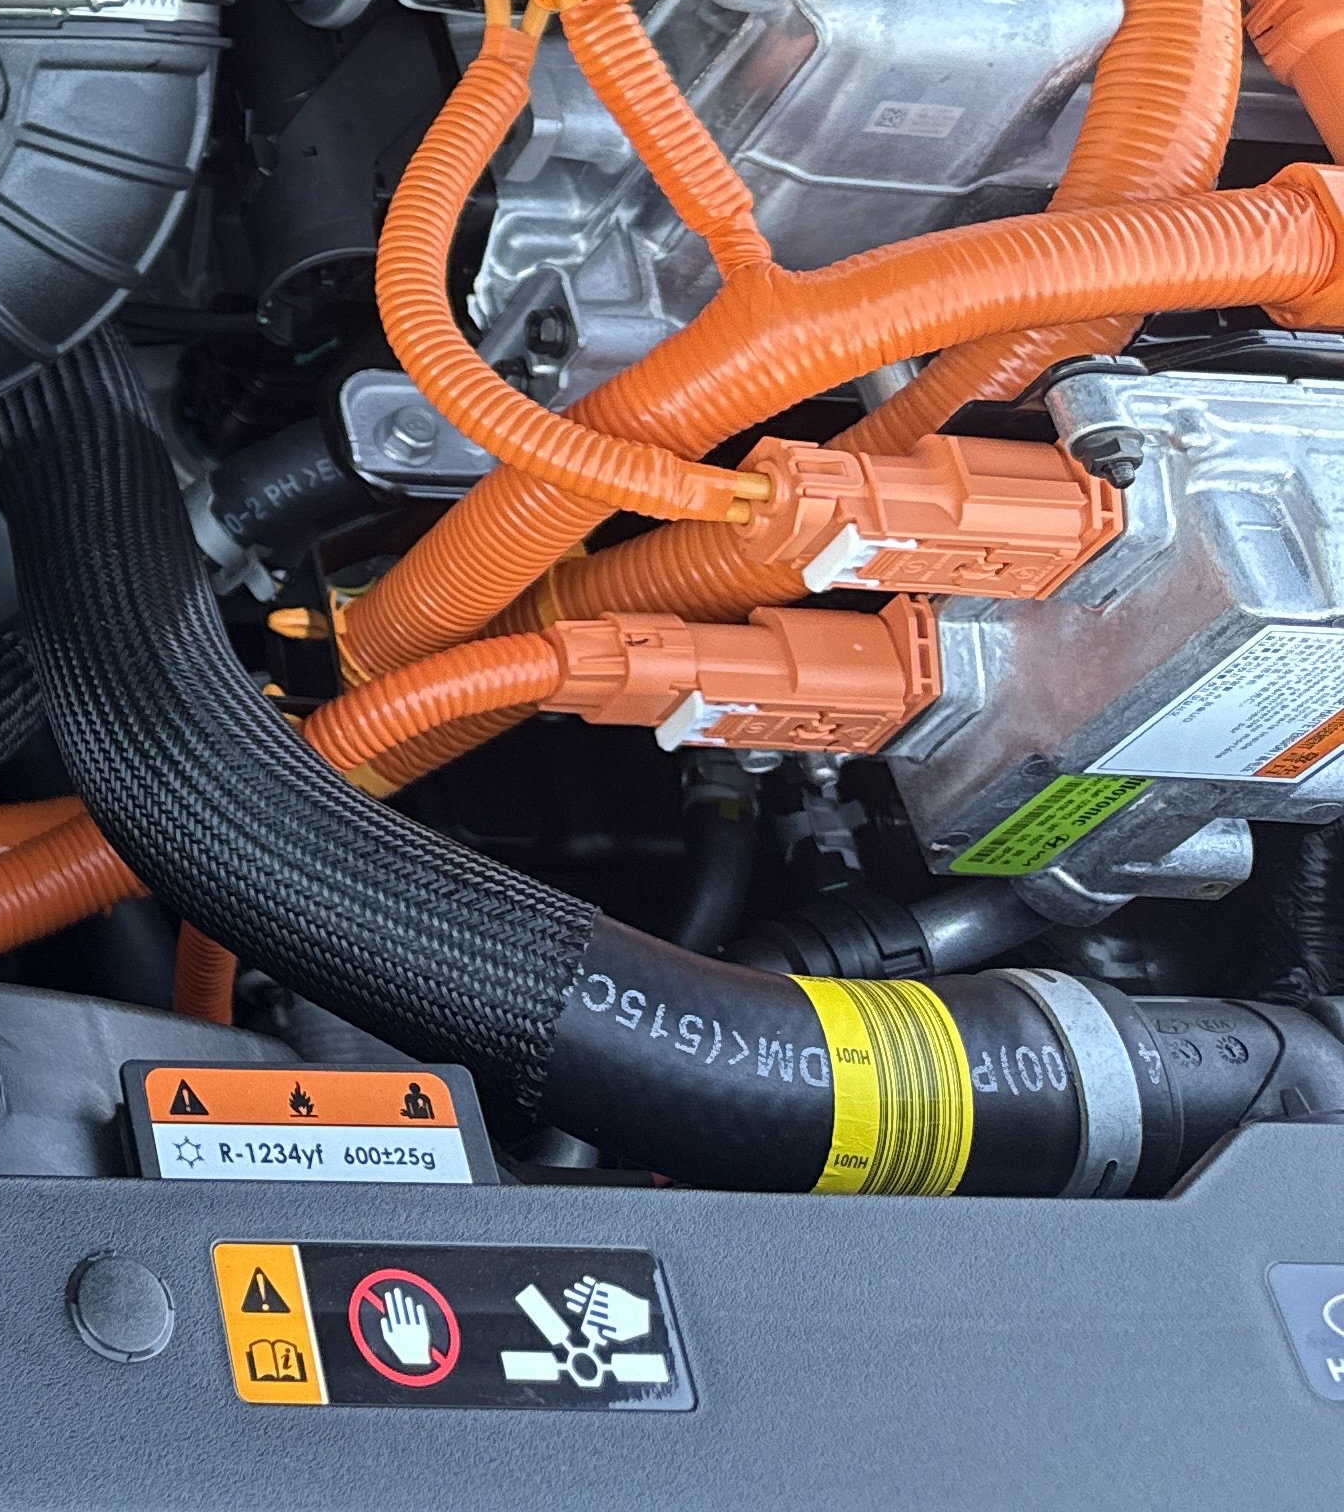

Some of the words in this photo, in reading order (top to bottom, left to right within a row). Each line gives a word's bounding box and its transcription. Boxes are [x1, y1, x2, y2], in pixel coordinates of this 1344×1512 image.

[835, 1045, 870, 1065] HU01
[218, 1141, 324, 1169] R-1234yf
[343, 1145, 436, 1170] 600±25g
[832, 1153, 869, 1169] HU01
